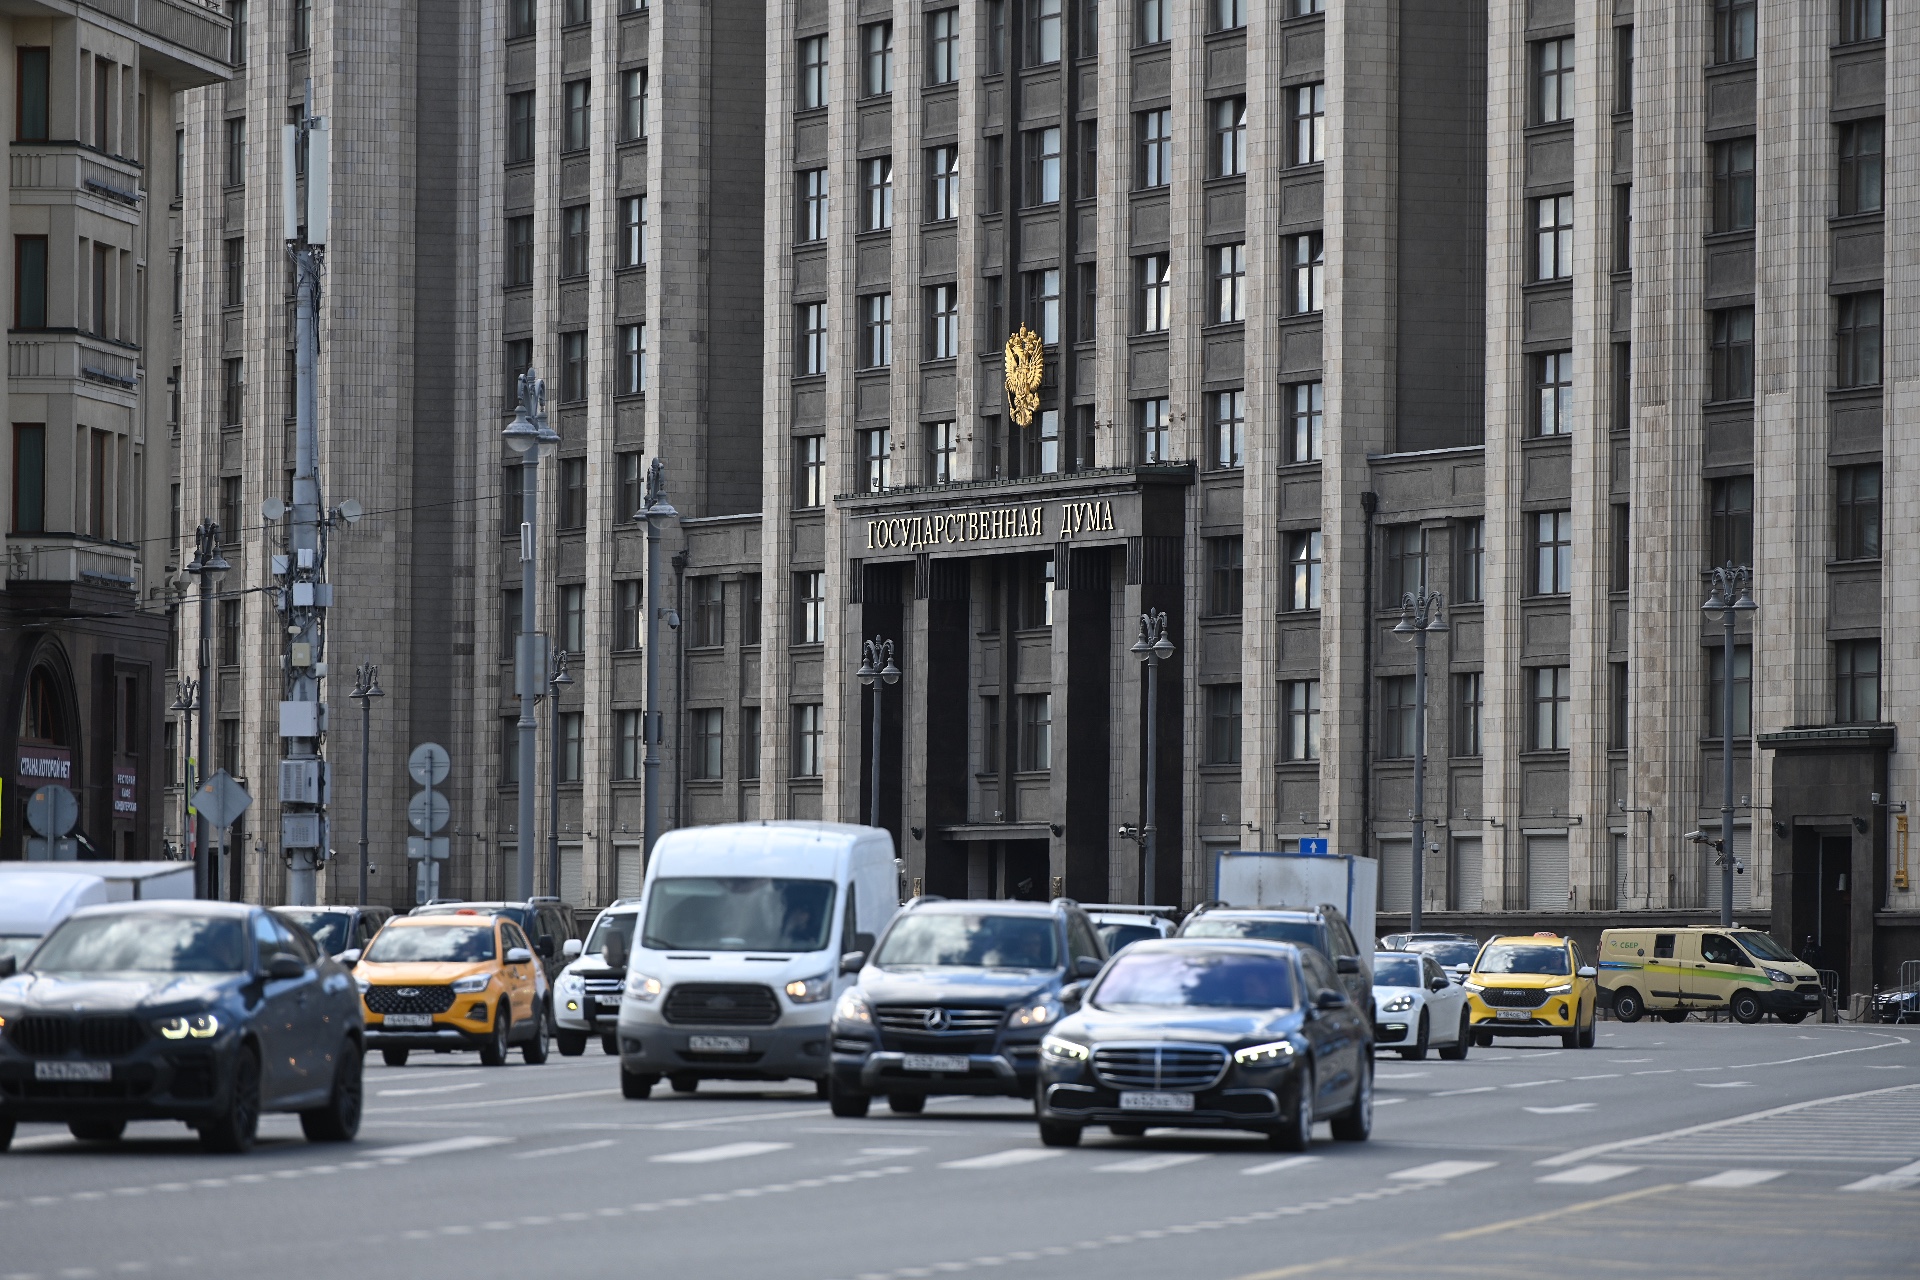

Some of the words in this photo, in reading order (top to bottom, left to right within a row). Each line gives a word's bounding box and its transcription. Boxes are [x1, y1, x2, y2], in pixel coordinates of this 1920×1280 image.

[867, 507, 1042, 551] ГОСУДАРСТВЕННАЯ
[1060, 500, 1114, 539] ДУМА
[61, 760, 70, 779] НЕТ
